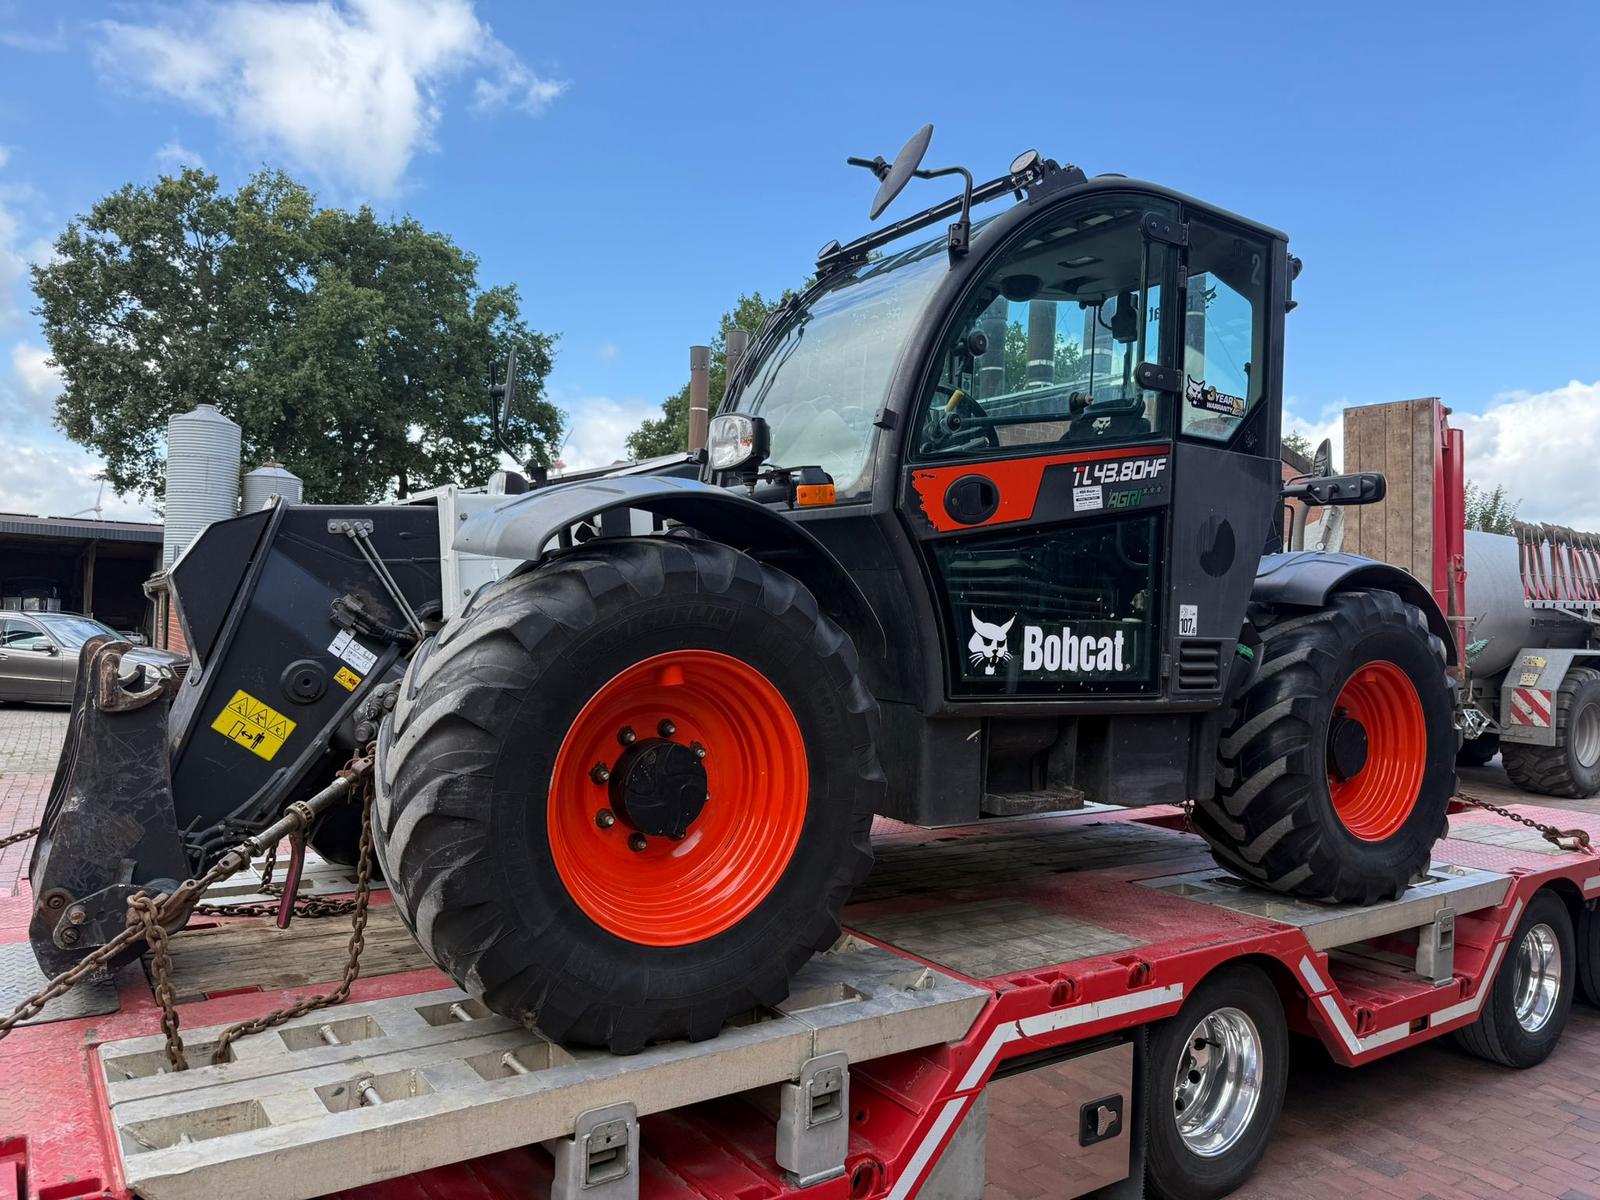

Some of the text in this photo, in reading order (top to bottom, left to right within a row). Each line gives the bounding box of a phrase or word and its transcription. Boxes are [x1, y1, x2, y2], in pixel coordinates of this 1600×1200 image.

[1215, 393, 1234, 406] YEAR
[1206, 401, 1233, 414] WARRANTY
[1107, 489, 1142, 508] AGRI
[1180, 618, 1193, 633] 107
[1023, 625, 1124, 672] Bobcat
